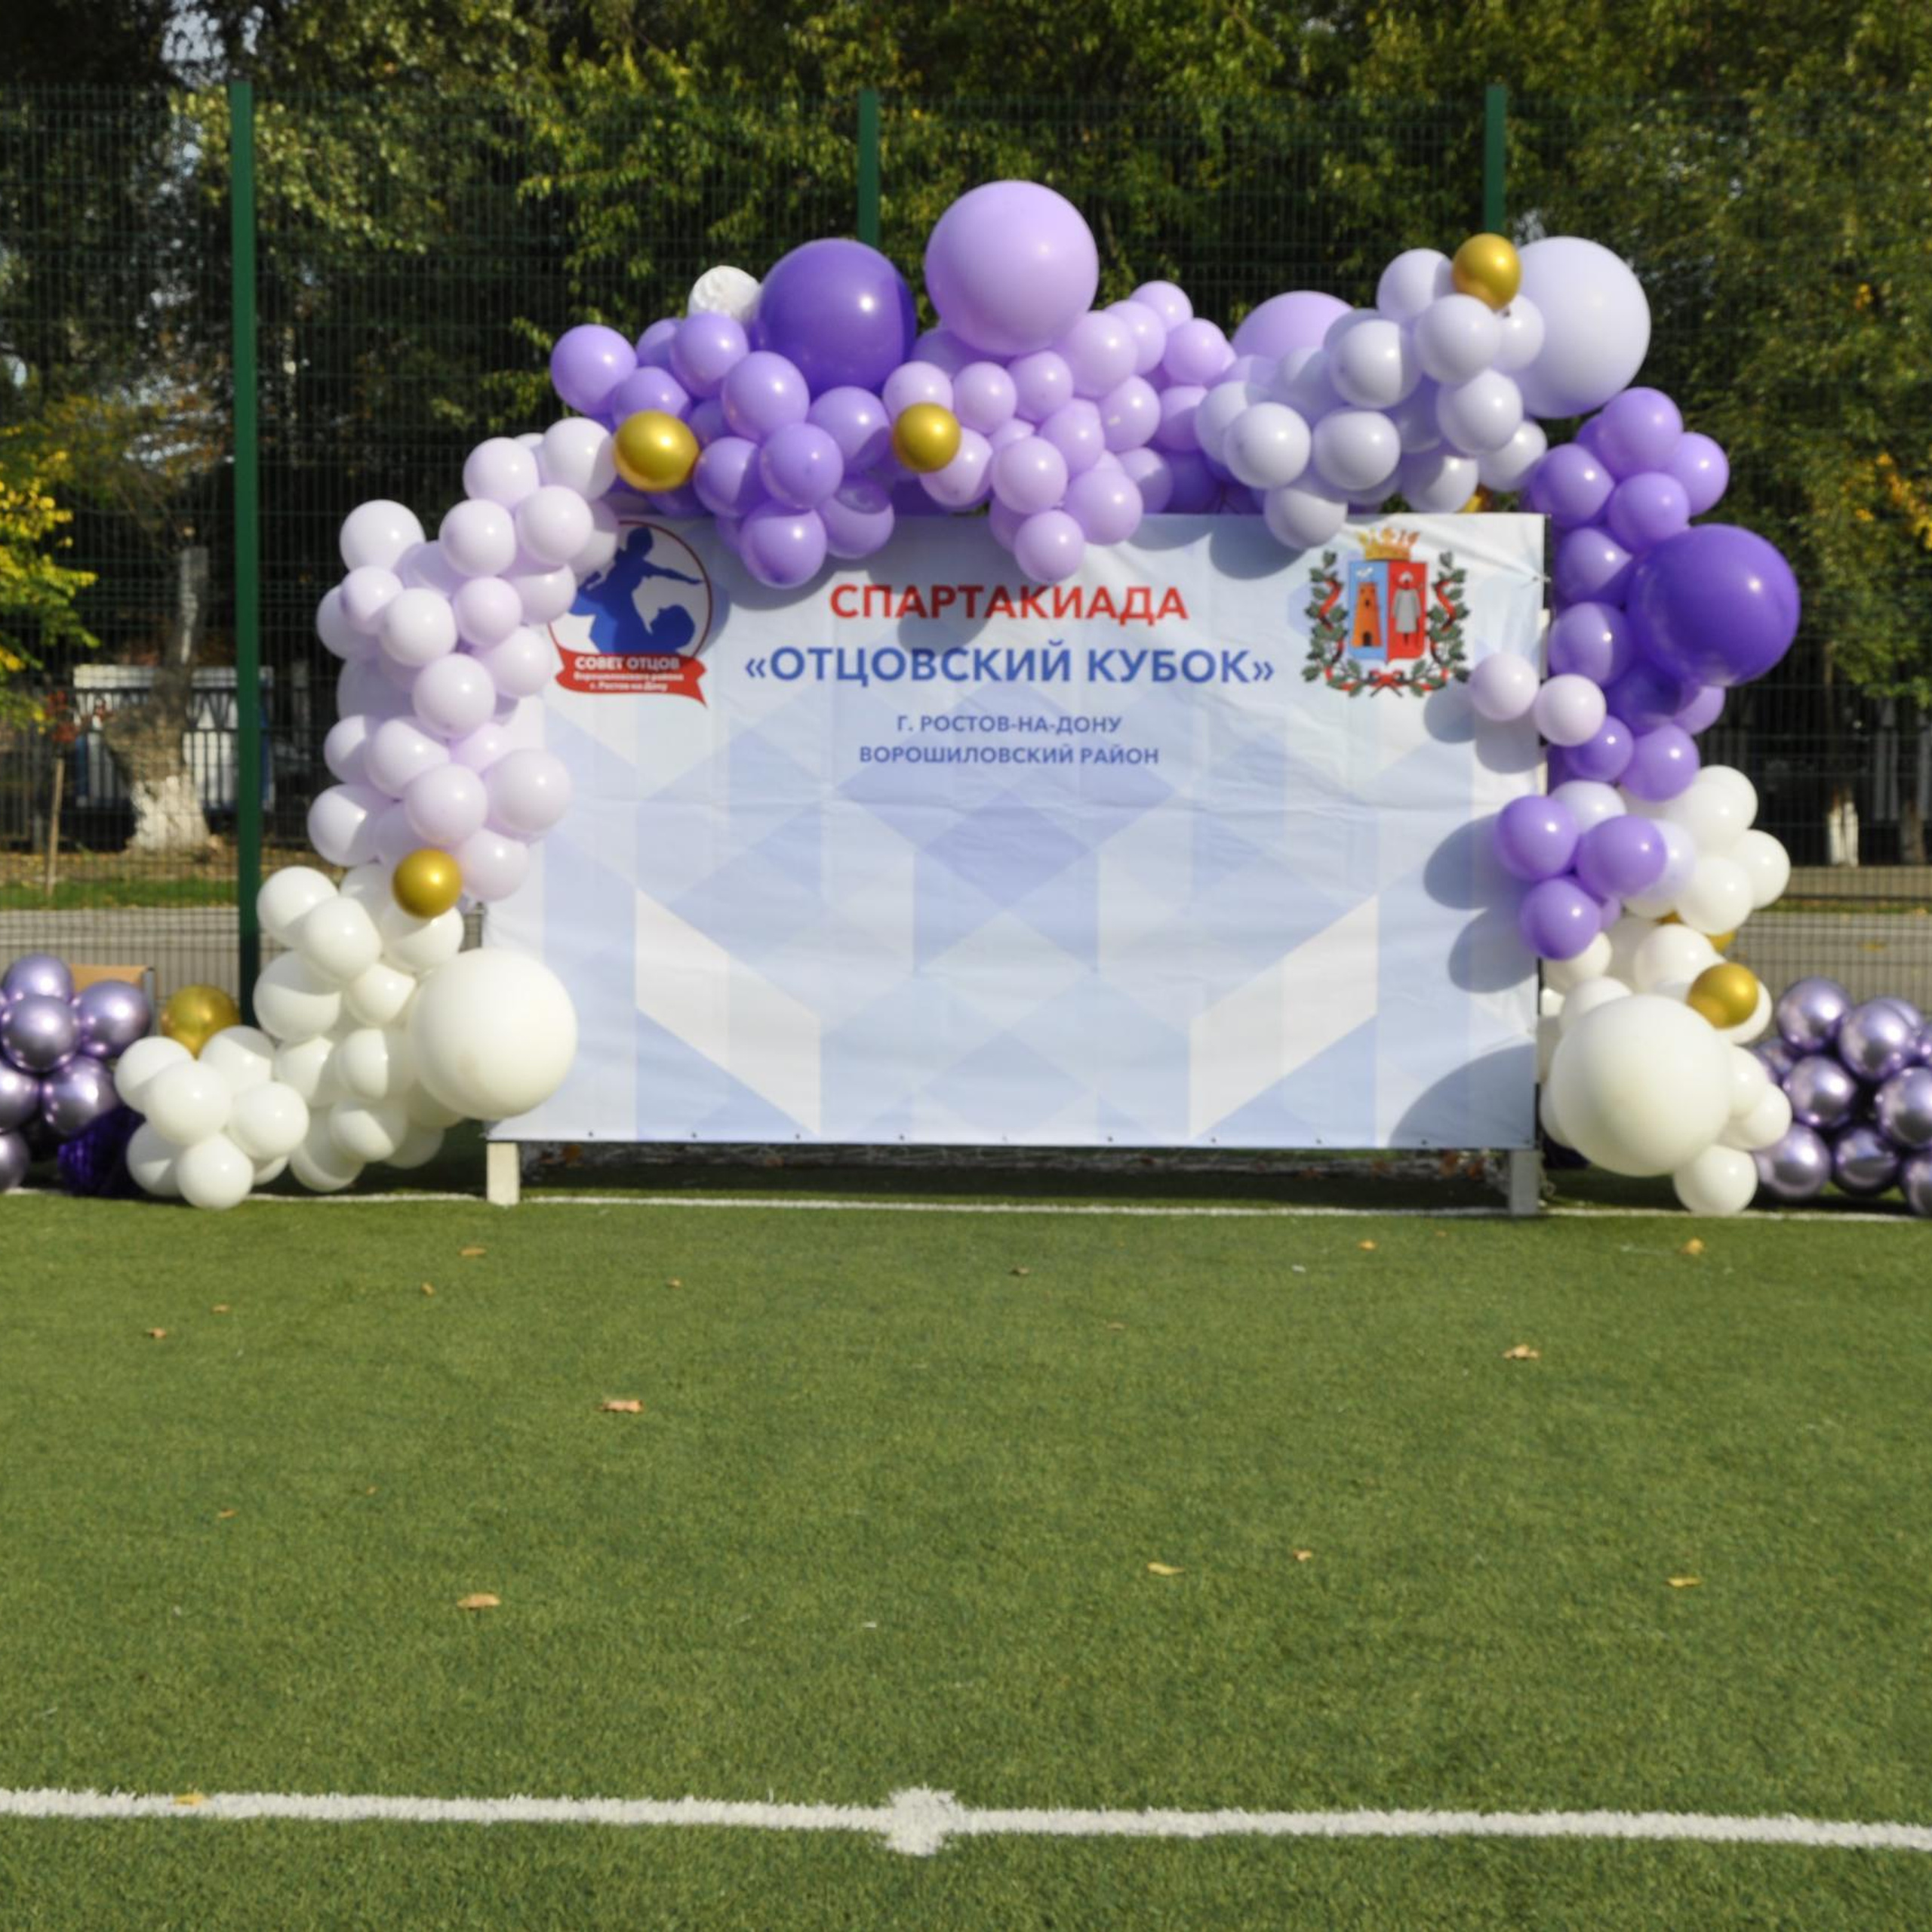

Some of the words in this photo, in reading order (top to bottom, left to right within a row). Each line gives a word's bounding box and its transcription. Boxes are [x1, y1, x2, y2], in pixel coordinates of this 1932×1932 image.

[829, 583, 1190, 626] СПАРТАКИАДА
[574, 656, 623, 670] СОВЕТ
[626, 656, 680, 672] ОТЦОВ
[745, 640, 1072, 688] «ОТЦОВСКИЙ
[1088, 648, 1275, 685] КУБОК»
[897, 715, 913, 733] Г.
[920, 715, 1123, 735] РОСТОВ-НА-ДОНУ
[859, 743, 1074, 764] ВОРОШИЛОВСКИЙ
[1080, 744, 1160, 765] РАЙОН
